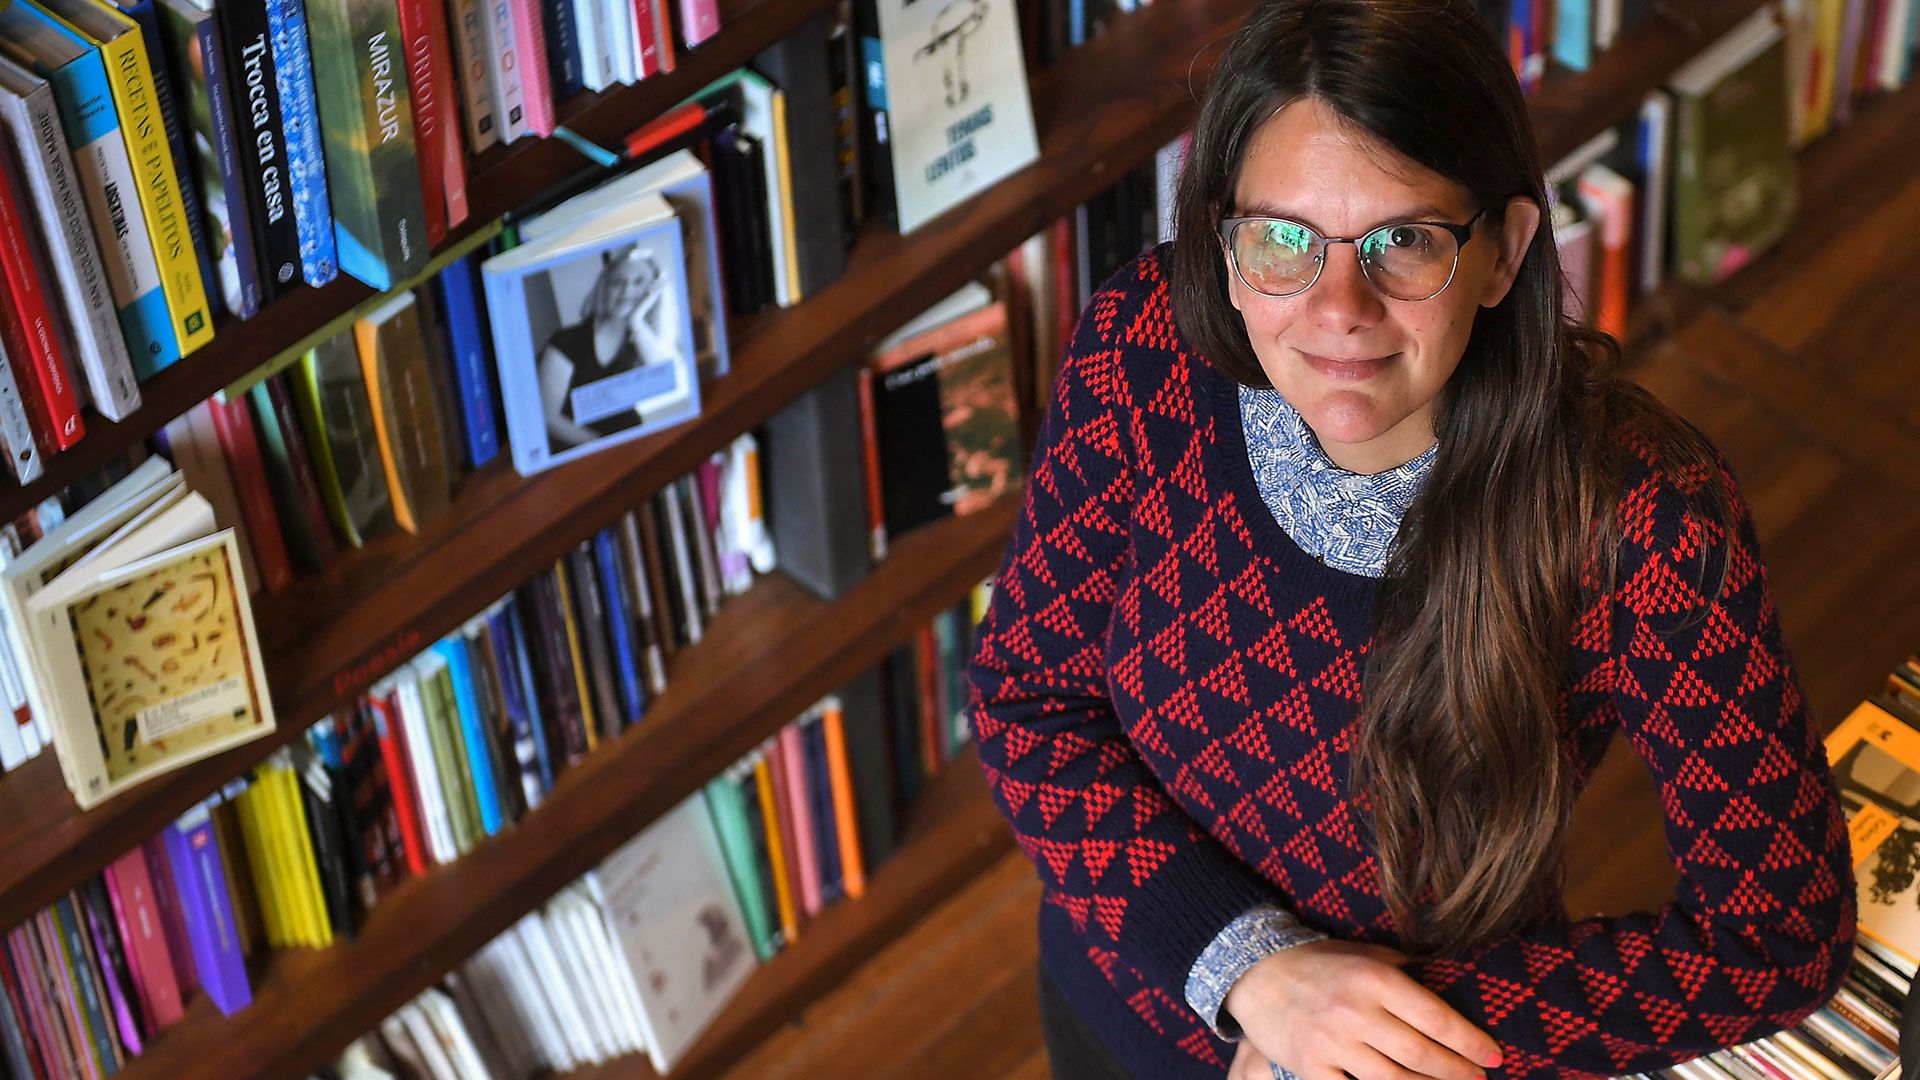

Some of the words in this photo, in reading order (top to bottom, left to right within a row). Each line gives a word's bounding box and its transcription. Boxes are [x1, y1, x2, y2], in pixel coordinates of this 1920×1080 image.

[242, 33, 270, 130] Trocca
[368, 30, 401, 144] MIRAZUR
[413, 35, 435, 138] ORIOLO
[38, 111, 58, 155] MADRE
[119, 48, 153, 138] RECETAS
[145, 154, 184, 259] PAPELITOS
[256, 129, 276, 165] en
[49, 154, 69, 190] MASA
[59, 189, 77, 215] CON
[262, 166, 284, 226] casa
